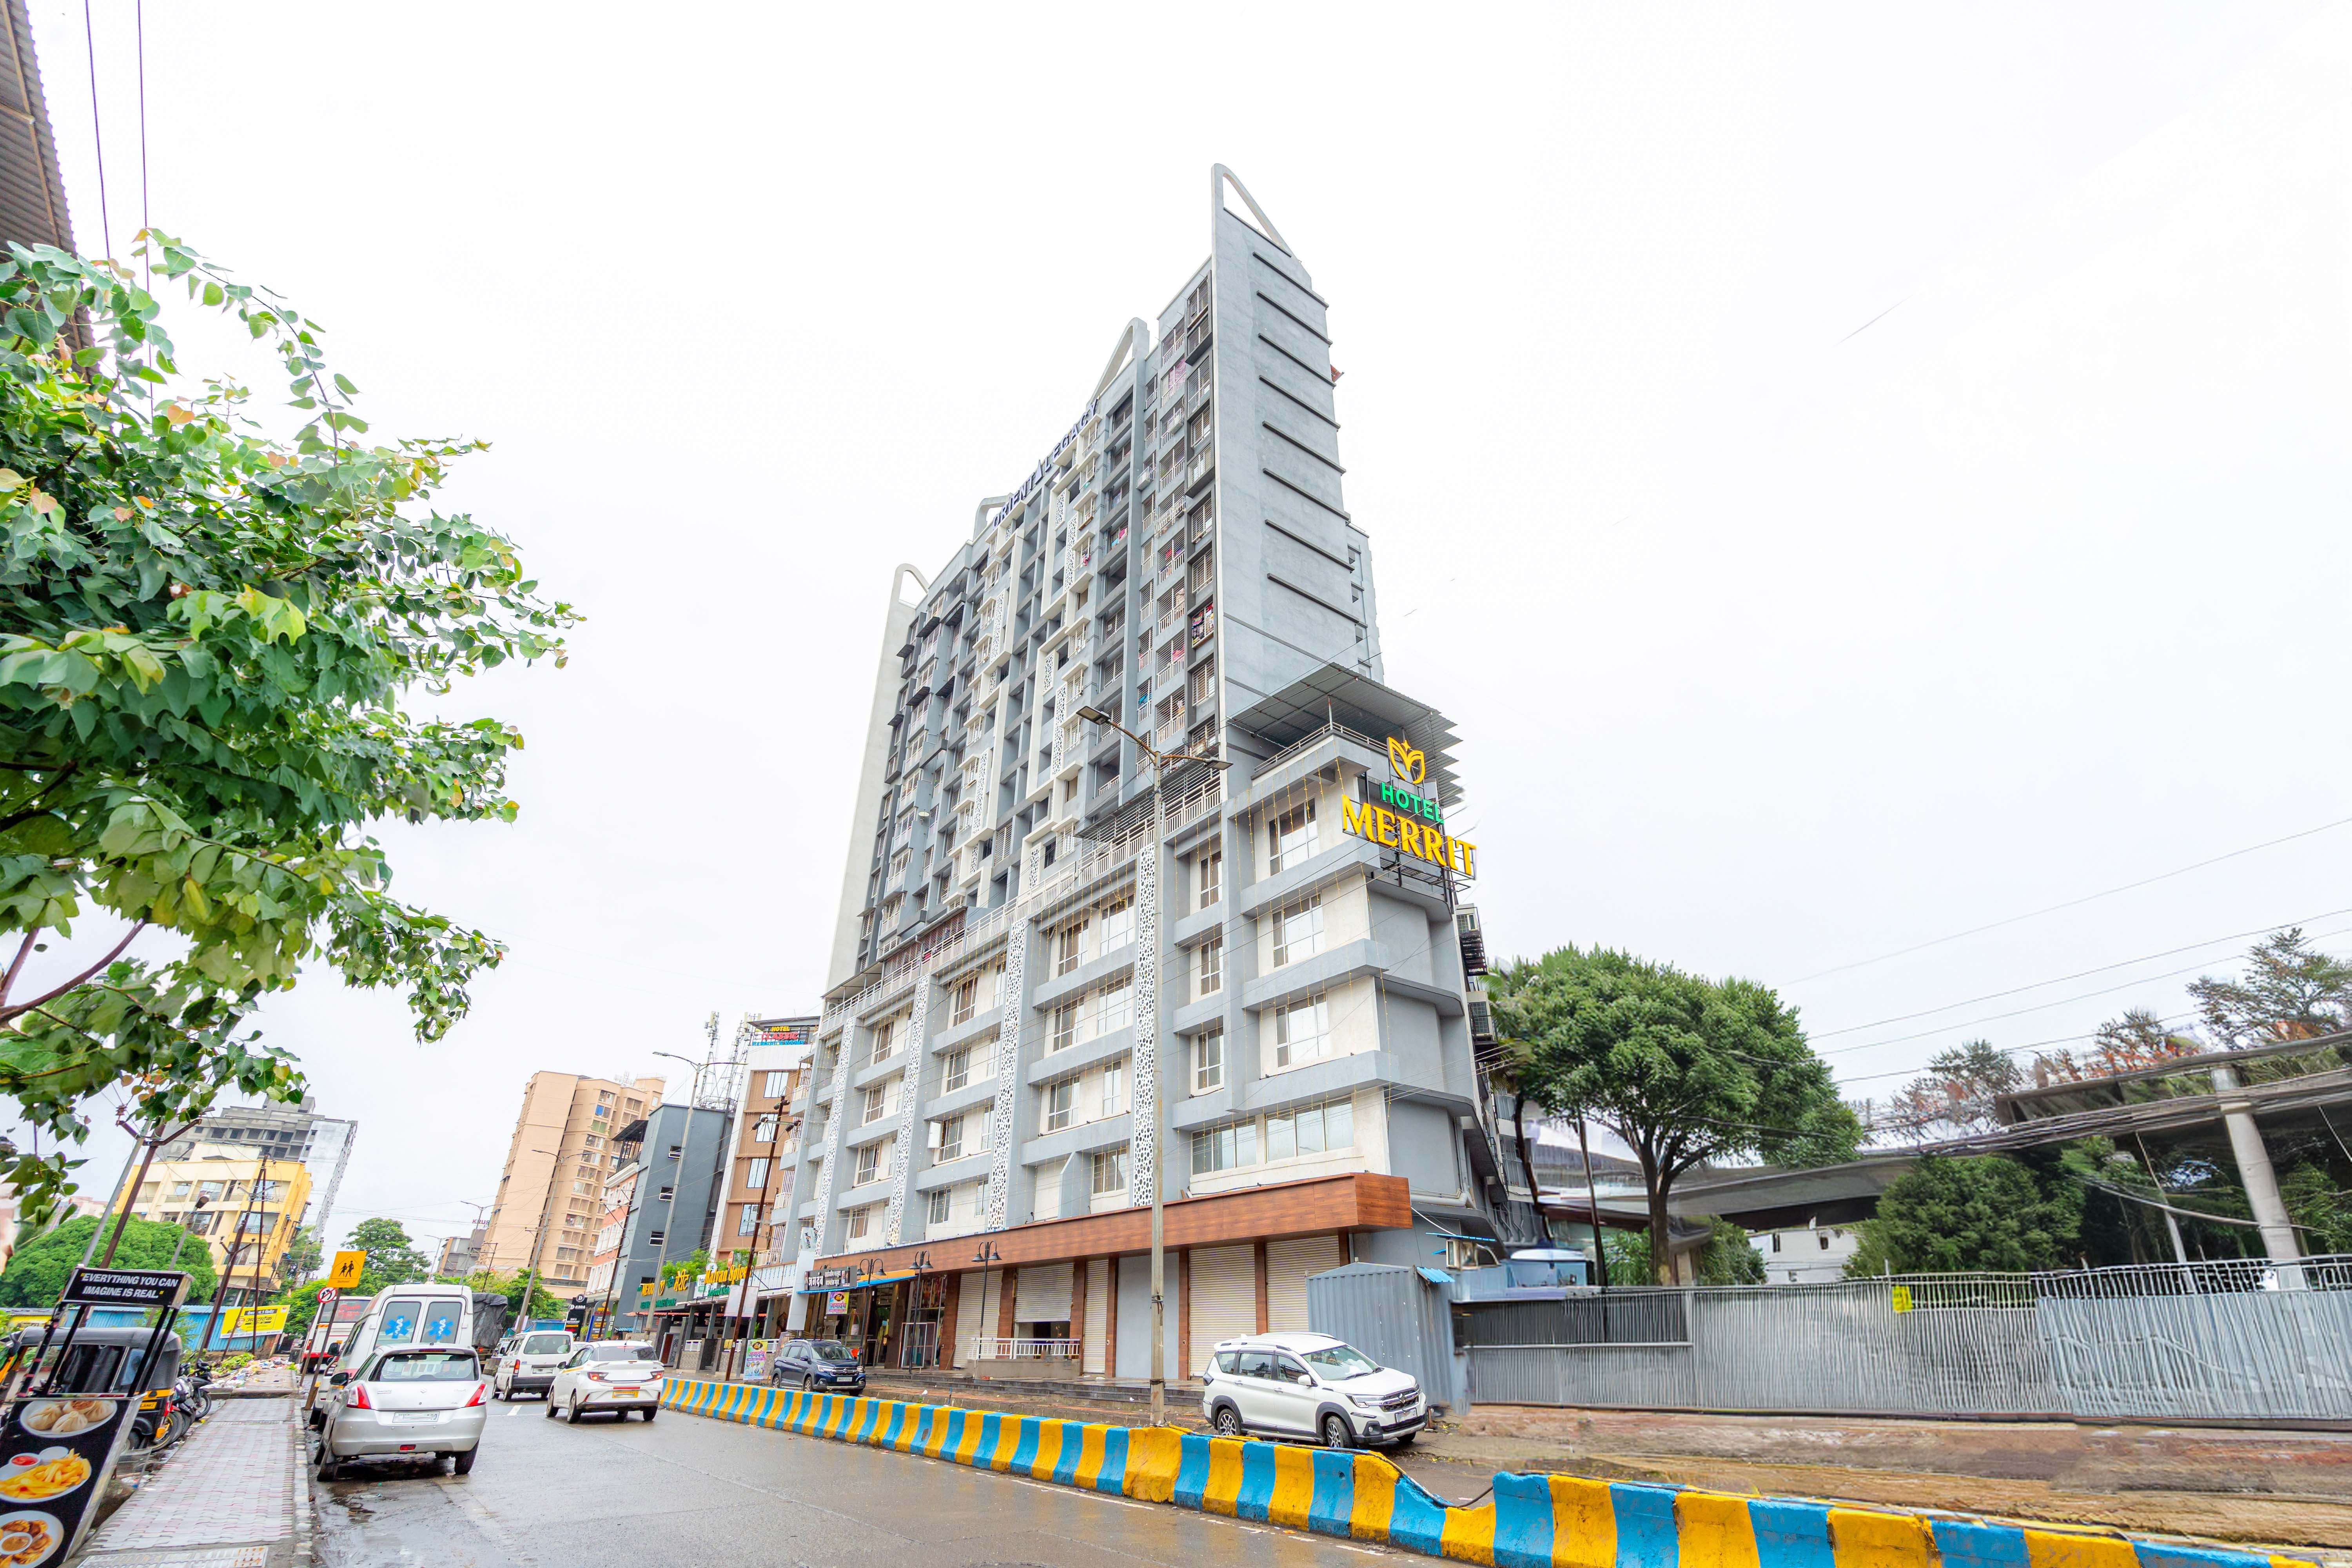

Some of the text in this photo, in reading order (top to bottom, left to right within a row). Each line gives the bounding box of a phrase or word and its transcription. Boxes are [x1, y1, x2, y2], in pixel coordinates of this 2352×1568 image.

[1380, 782, 1445, 824] HOTEL
[1342, 794, 1477, 876] MERRIT
[140, 1277, 158, 1286] YOU
[158, 1278, 179, 1287] CAN
[704, 1268, 728, 1284] Malvan
[82, 1285, 123, 1297] IMAGINE
[122, 1288, 133, 1297] IS
